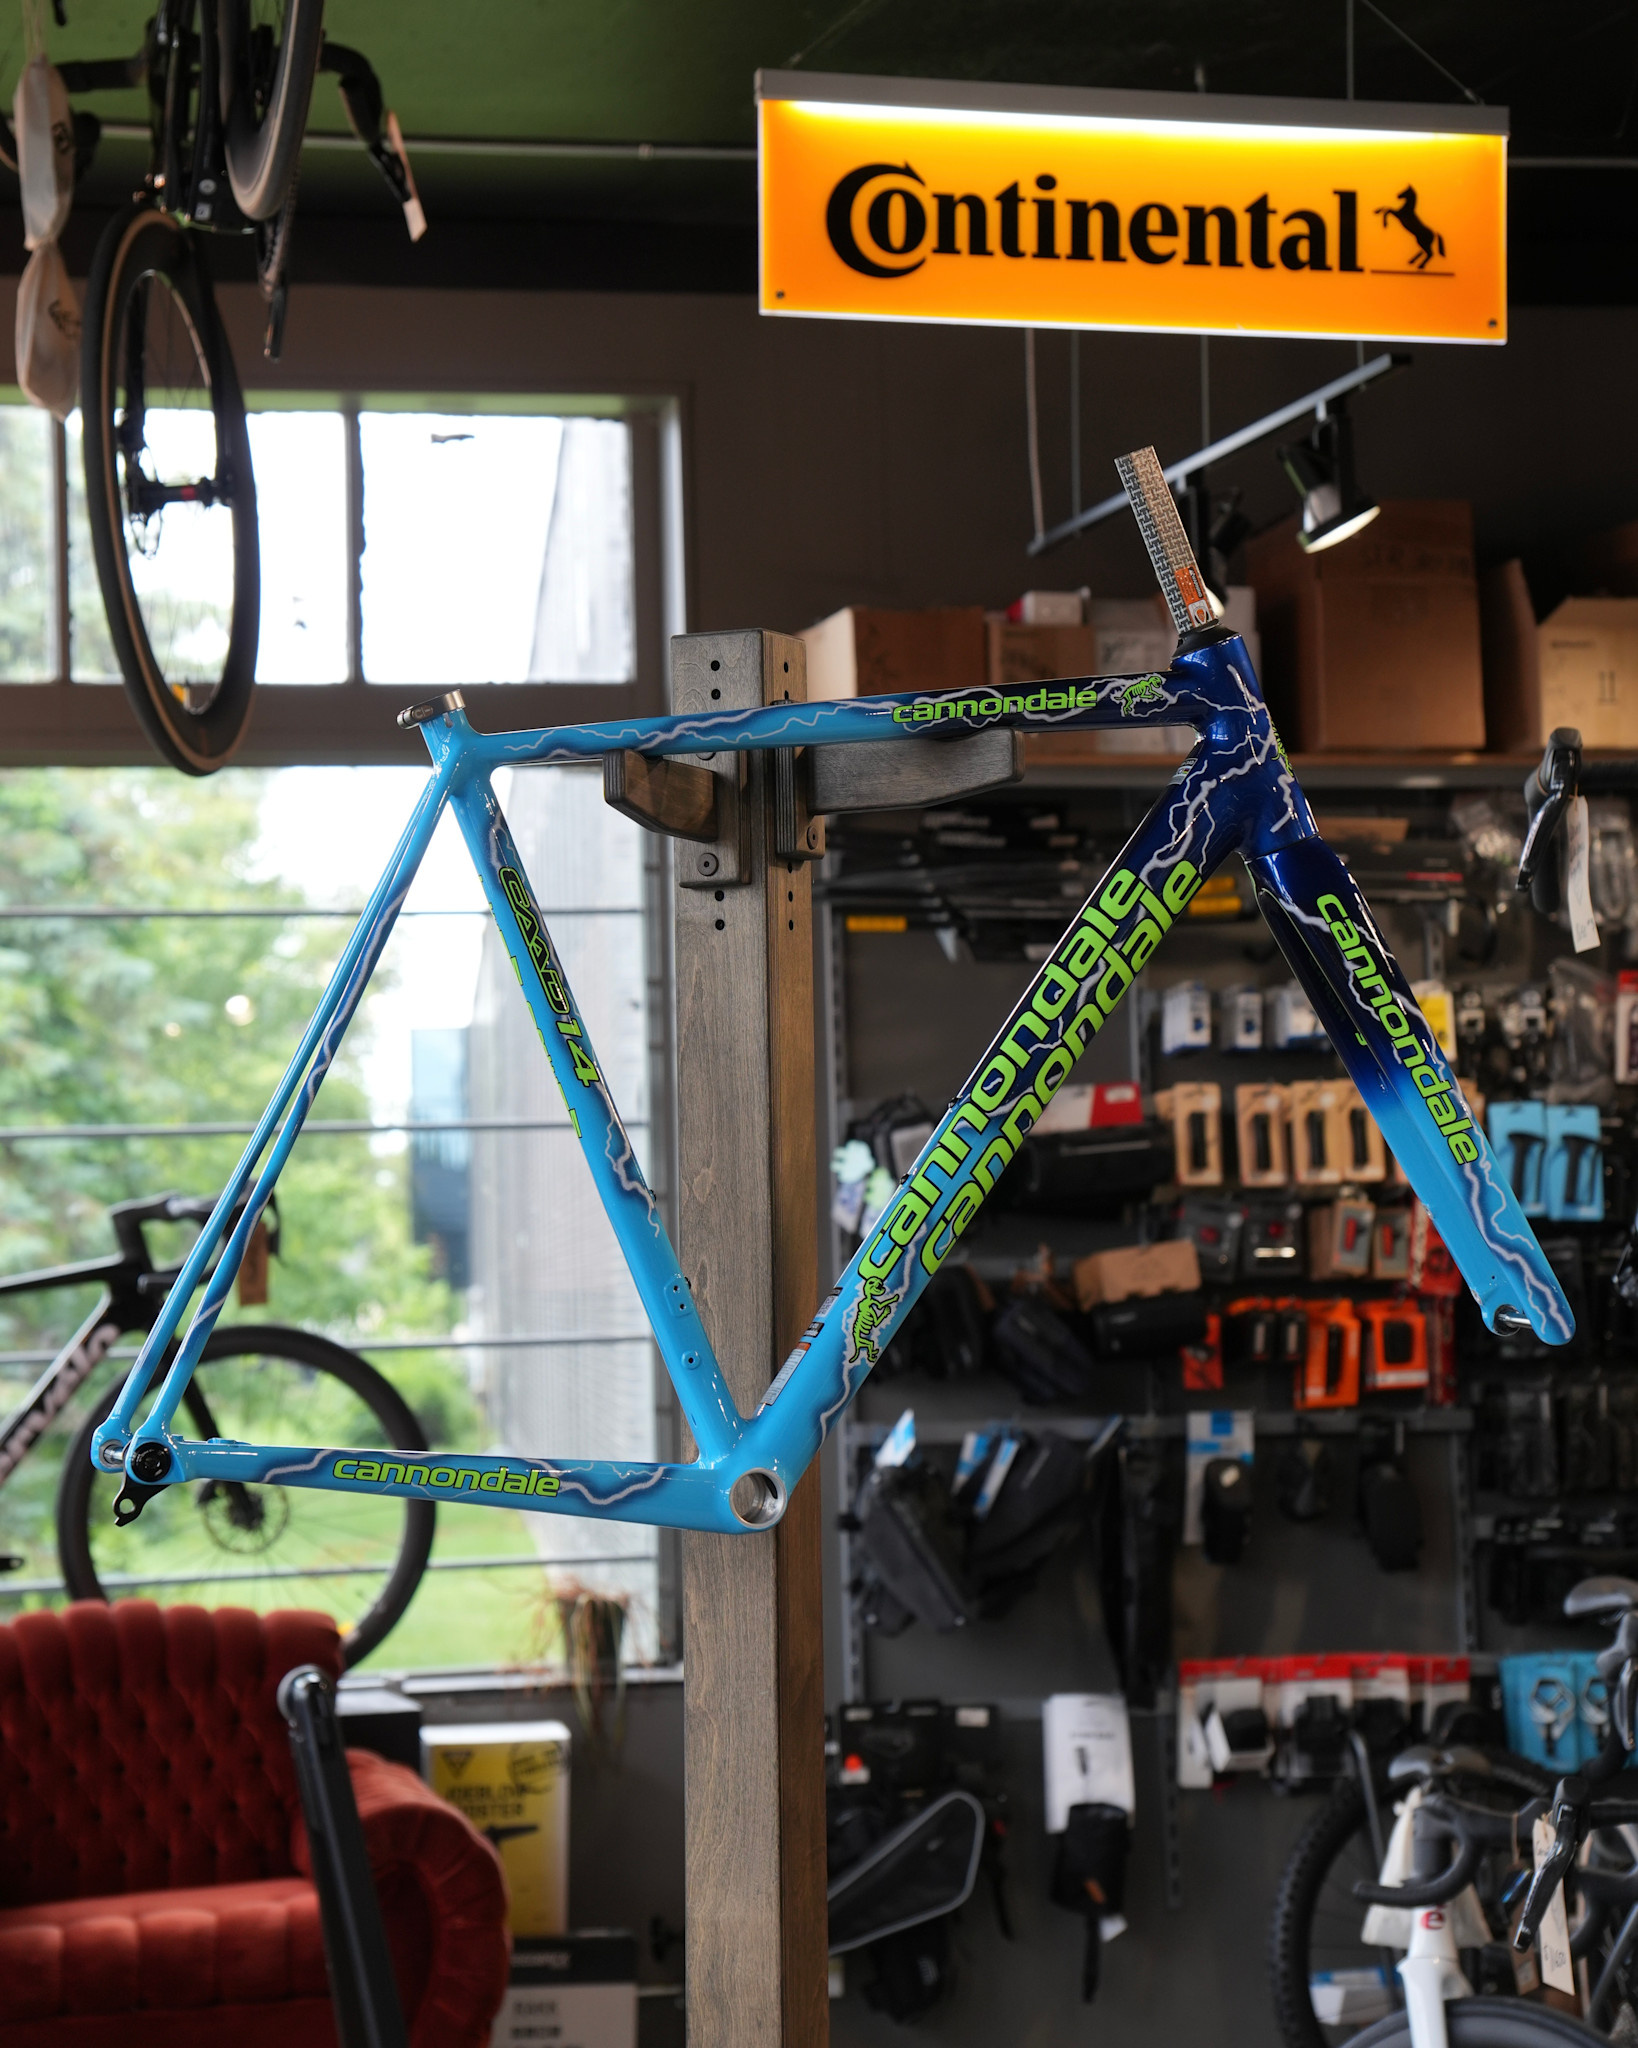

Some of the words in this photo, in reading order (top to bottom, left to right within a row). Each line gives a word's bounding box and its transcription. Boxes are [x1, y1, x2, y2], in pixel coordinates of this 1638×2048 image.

[825, 161, 1365, 278] Continental
[892, 686, 1099, 724] cannondale
[857, 867, 1144, 1281] cannondale
[920, 859, 1203, 1277] cannondale
[1315, 893, 1478, 1166] cannondale
[332, 1459, 561, 1498] cannondale
